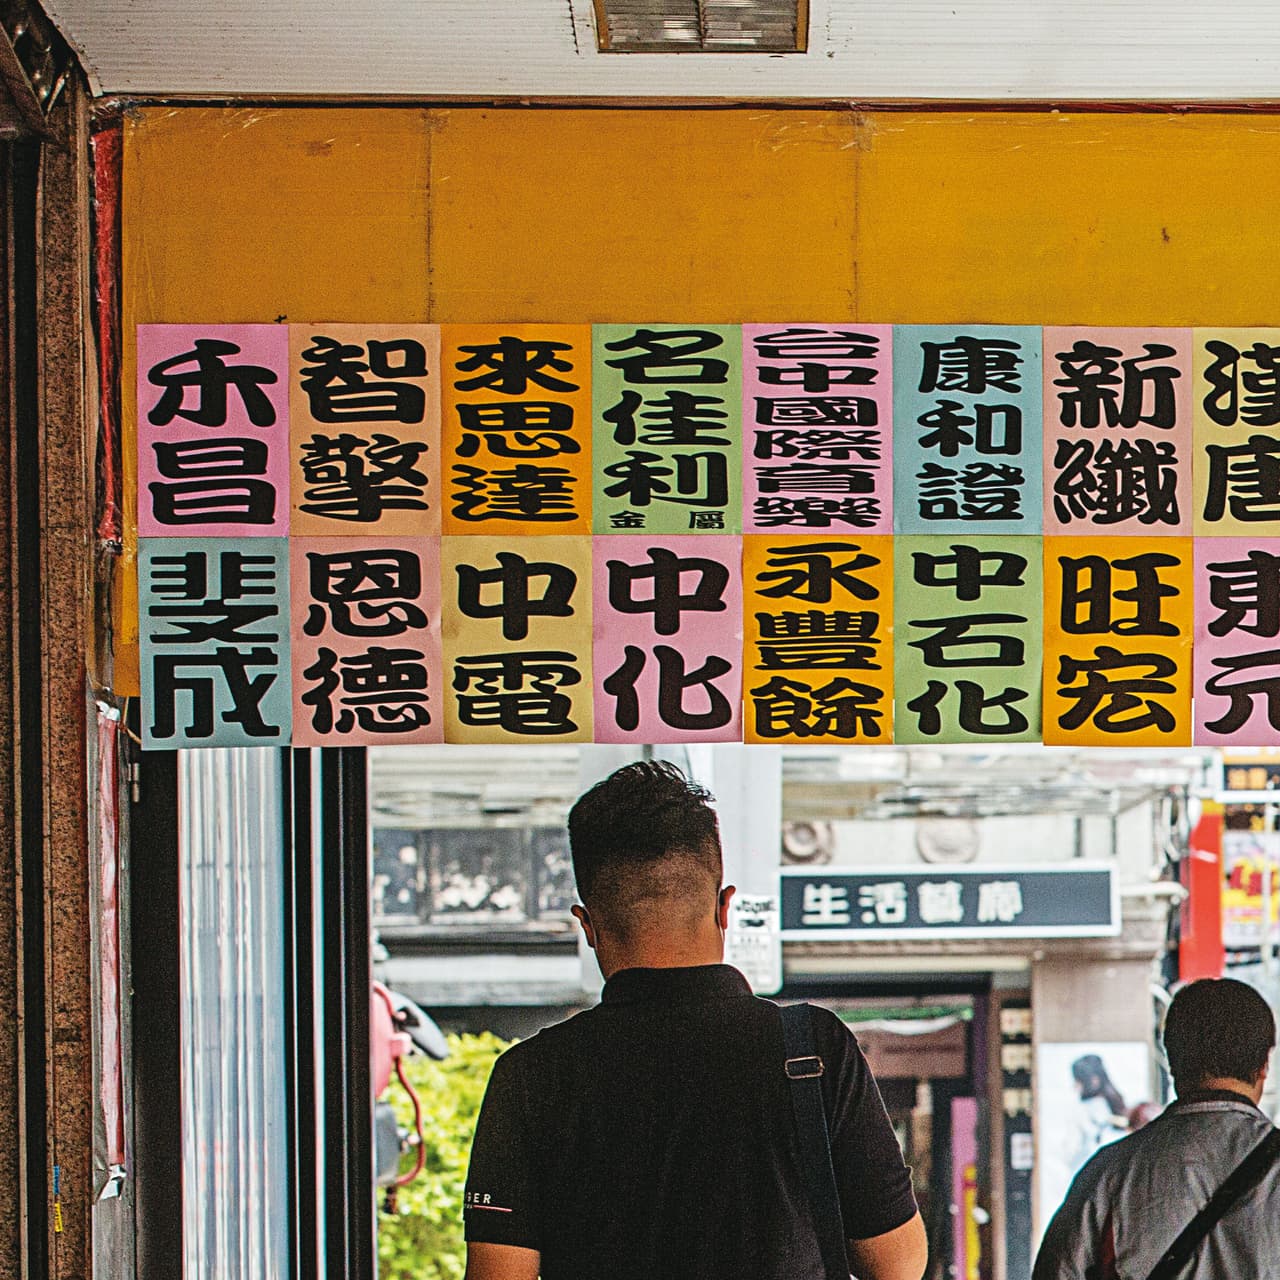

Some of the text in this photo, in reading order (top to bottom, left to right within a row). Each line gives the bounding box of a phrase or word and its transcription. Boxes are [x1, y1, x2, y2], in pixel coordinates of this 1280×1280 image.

[147, 338, 278, 526] 禾昌
[298, 335, 430, 523] 智擎
[450, 336, 582, 523] 來思達
[602, 328, 732, 508] 名佳利
[752, 328, 883, 528] 台中國際育樂
[915, 335, 1026, 521] 康和證
[1052, 340, 1182, 526] 新纖
[148, 551, 280, 739] 斐成
[301, 549, 432, 735] 恩德
[451, 551, 582, 736] 中電
[603, 547, 732, 732] 中化
[749, 542, 885, 739] 永豐餘
[906, 544, 1029, 736] 中石化
[1056, 552, 1182, 734] 旺宏
